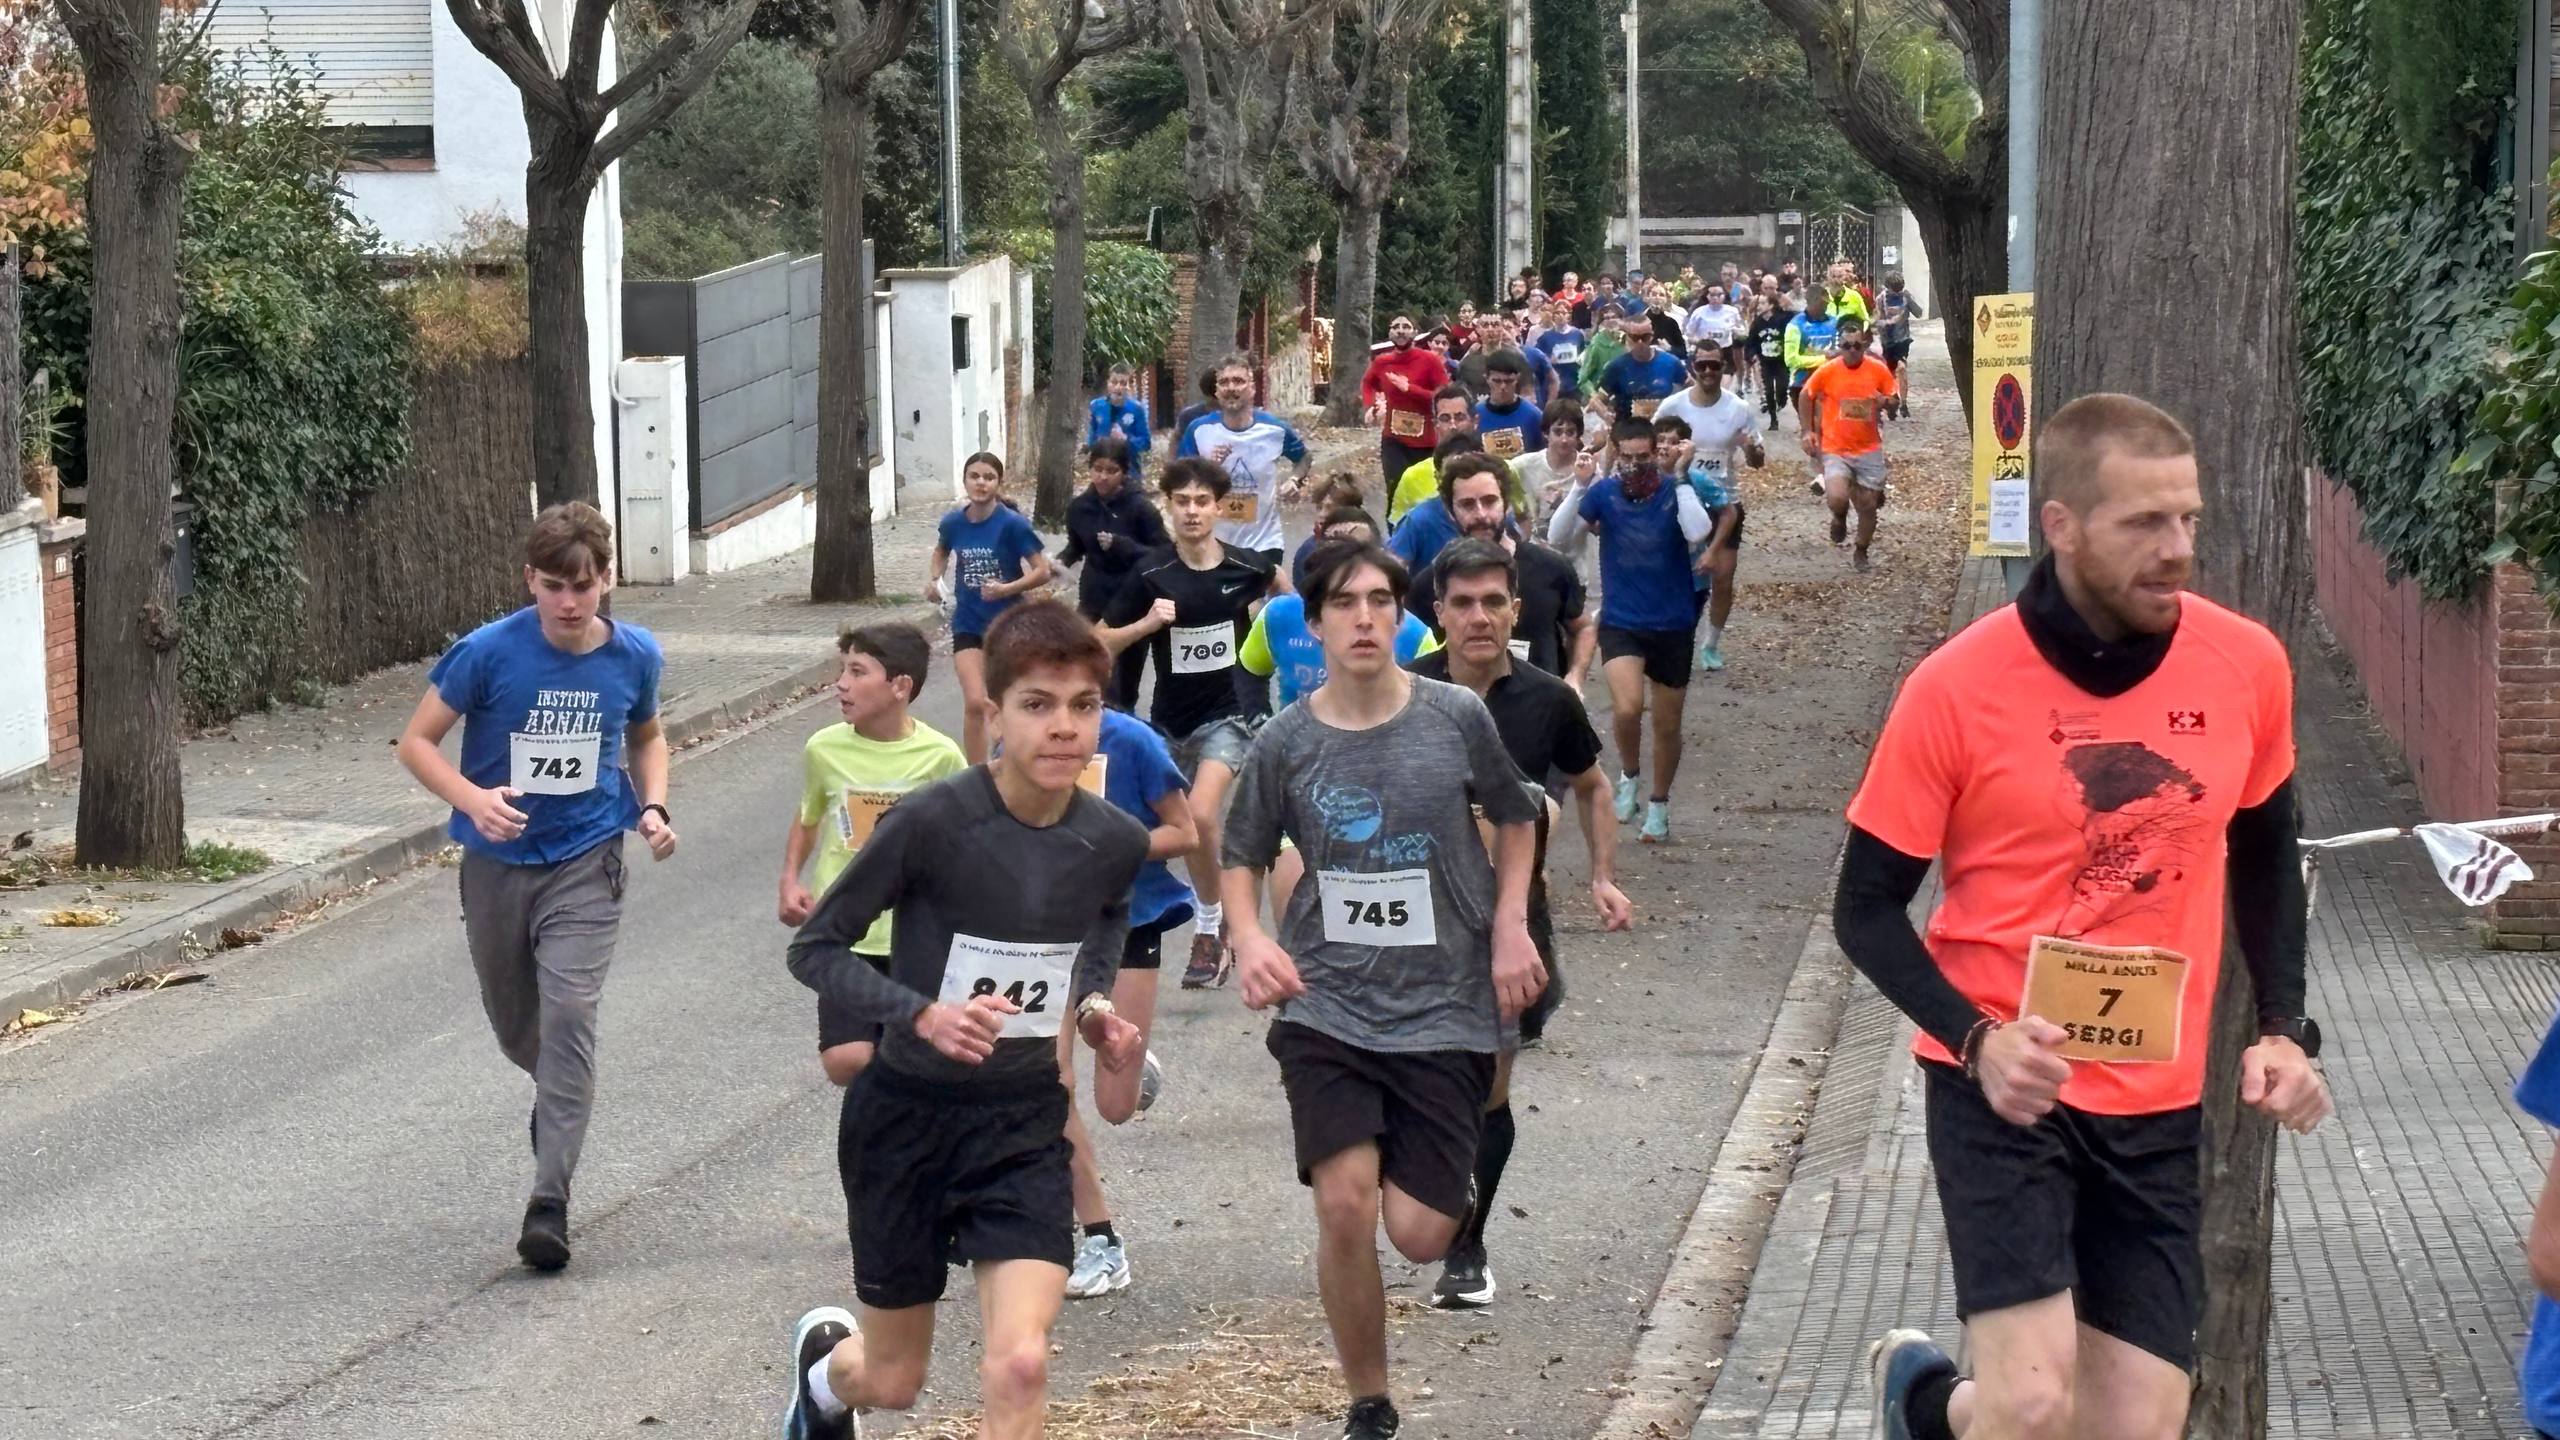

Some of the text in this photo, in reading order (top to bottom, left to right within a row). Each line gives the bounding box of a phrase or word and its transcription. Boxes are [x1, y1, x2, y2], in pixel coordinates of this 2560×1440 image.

[1180, 640, 1228, 662] 700
[536, 689, 600, 708] INSTITUT
[523, 709, 603, 735] ARNAU
[529, 757, 582, 779] 742
[1343, 899, 1409, 927] 745
[2063, 959, 2159, 977] MILLA ADULTS
[968, 977, 1049, 1014] 842
[2097, 987, 2125, 1017] 7
[2062, 1021, 2144, 1047] SERGI
